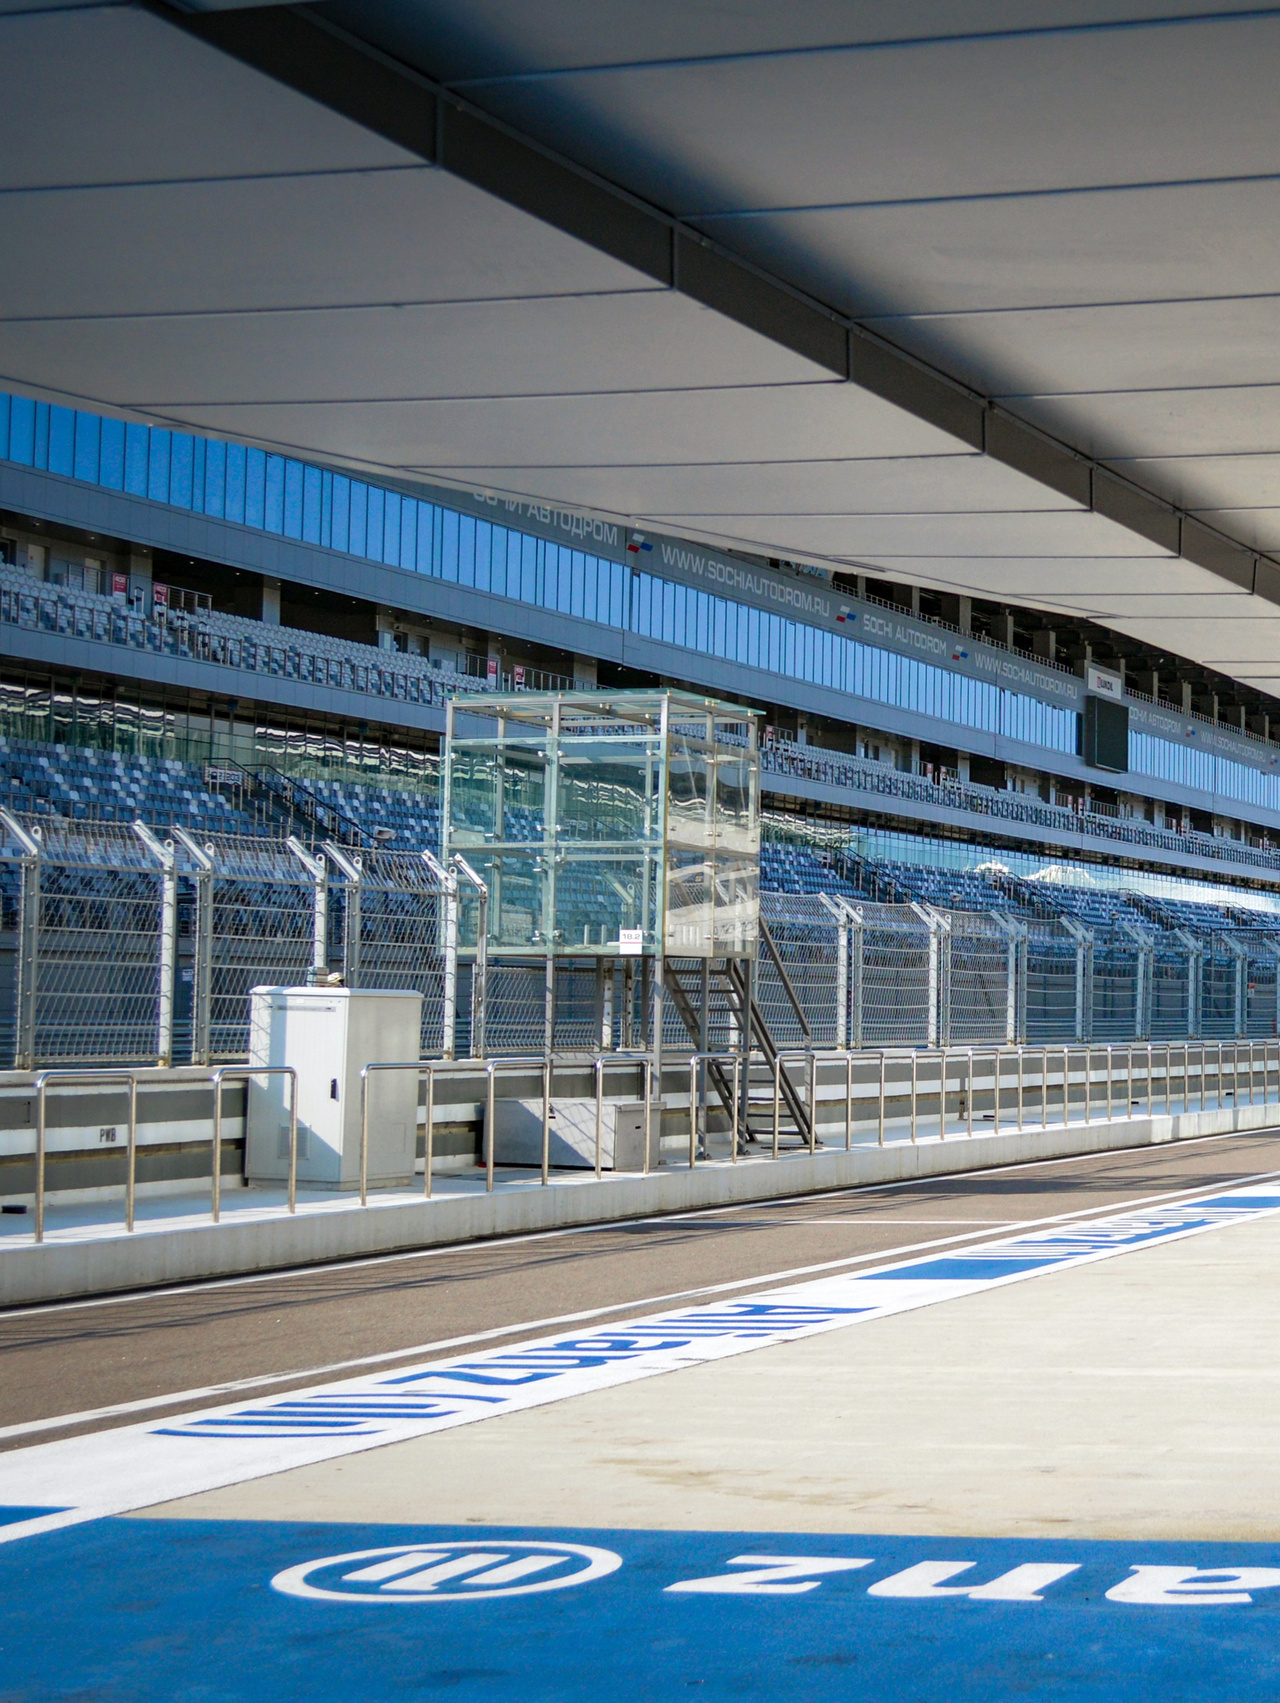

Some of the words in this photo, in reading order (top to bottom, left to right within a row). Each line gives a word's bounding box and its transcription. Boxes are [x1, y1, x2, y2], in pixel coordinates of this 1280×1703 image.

[526, 503, 618, 546] АВТОДРОМ
[661, 543, 830, 618] WWW.SOCHIAUTODROM.RU
[863, 613, 893, 637] SOCHI
[895, 623, 947, 656] AUTODROM
[378, 1303, 881, 1387] Allianz
